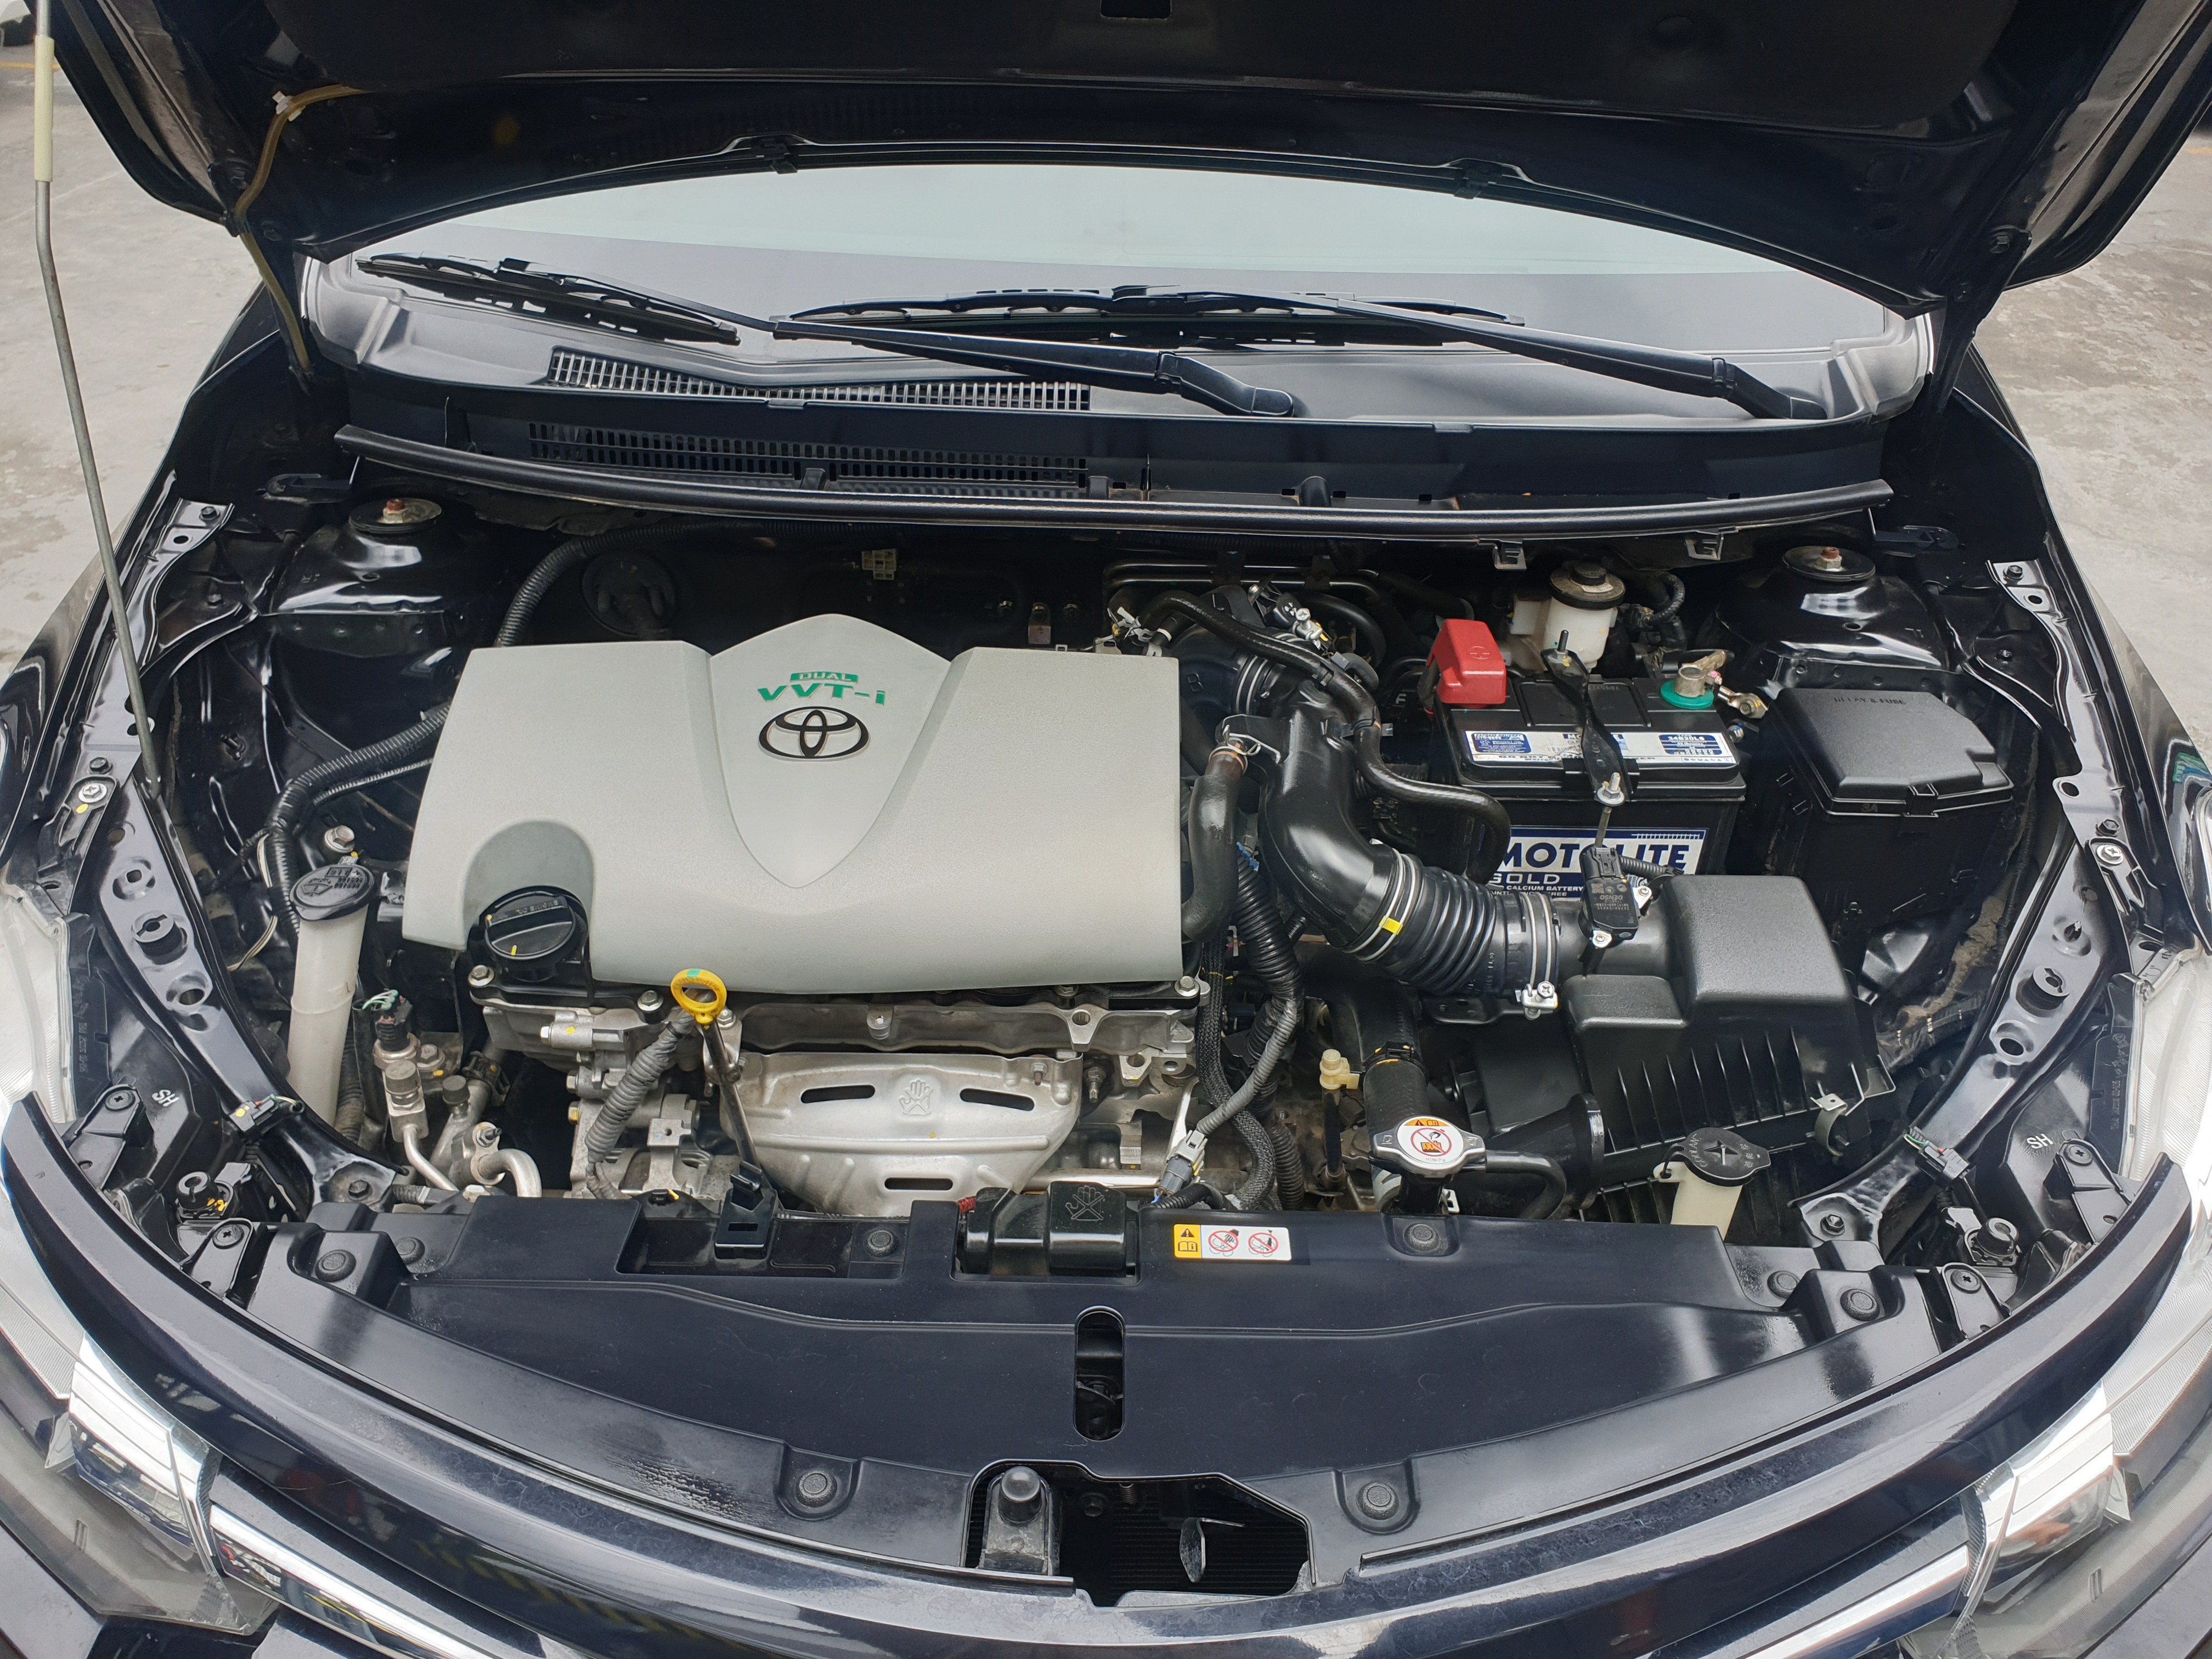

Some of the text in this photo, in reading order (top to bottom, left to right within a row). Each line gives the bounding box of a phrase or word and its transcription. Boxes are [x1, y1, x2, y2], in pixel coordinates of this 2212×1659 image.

[798, 672, 852, 681] DUAL
[757, 682, 886, 706] VVT-i
[1488, 873, 1560, 885] GOLD
[152, 1089, 180, 1107] SH
[2026, 1133, 2054, 1150] SH
